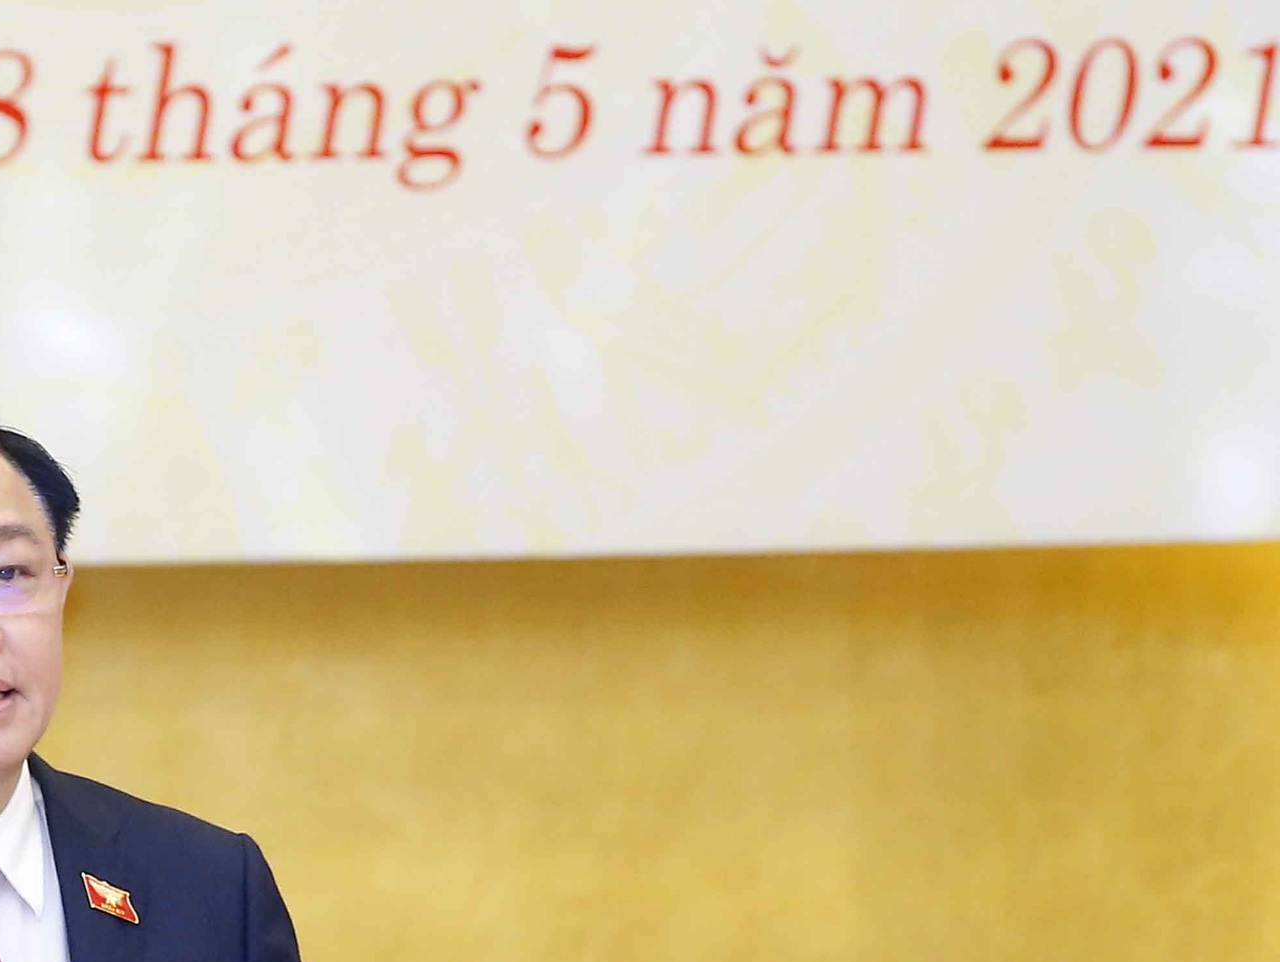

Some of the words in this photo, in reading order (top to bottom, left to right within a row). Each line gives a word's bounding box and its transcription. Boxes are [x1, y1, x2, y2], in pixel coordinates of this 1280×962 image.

[86, 41, 483, 190] tháng
[524, 45, 597, 160] 5
[644, 43, 928, 157] năm
[982, 36, 1280, 155] 2021
